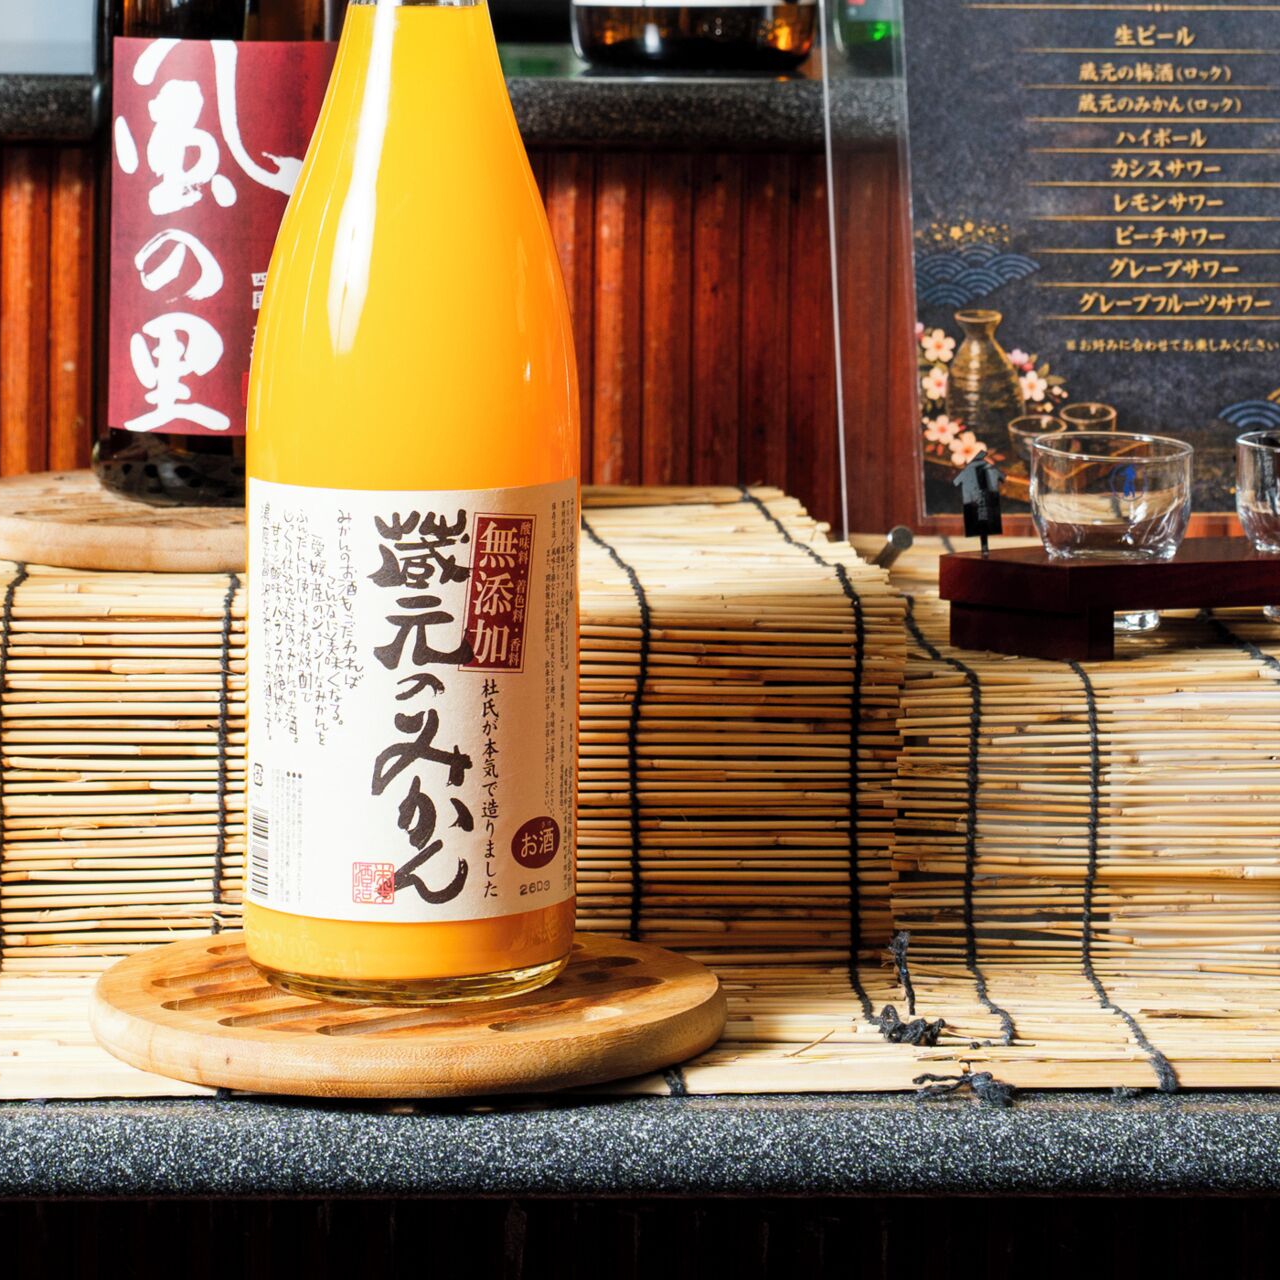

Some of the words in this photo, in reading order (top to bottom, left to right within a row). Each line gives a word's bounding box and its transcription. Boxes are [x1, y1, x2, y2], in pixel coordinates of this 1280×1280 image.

[1114, 25, 1195, 48] 生ビール
[1116, 129, 1207, 149] ハイボール
[1110, 159, 1221, 179] カシスサワー
[1113, 193, 1223, 213] レモンサワー
[114, 38, 304, 433] 風の里
[1115, 227, 1226, 247] ピーチサワー
[1109, 258, 1240, 279] グレープサワー
[1078, 293, 1272, 315] グレープフルーツサワー
[337, 509, 364, 690] みかんのお酒もこだわれば
[469, 520, 519, 664] 無添加
[366, 509, 475, 905] 蔵元のみかん
[481, 678, 500, 899] 杜氏が本気で造りました
[521, 827, 554, 858] お酒
